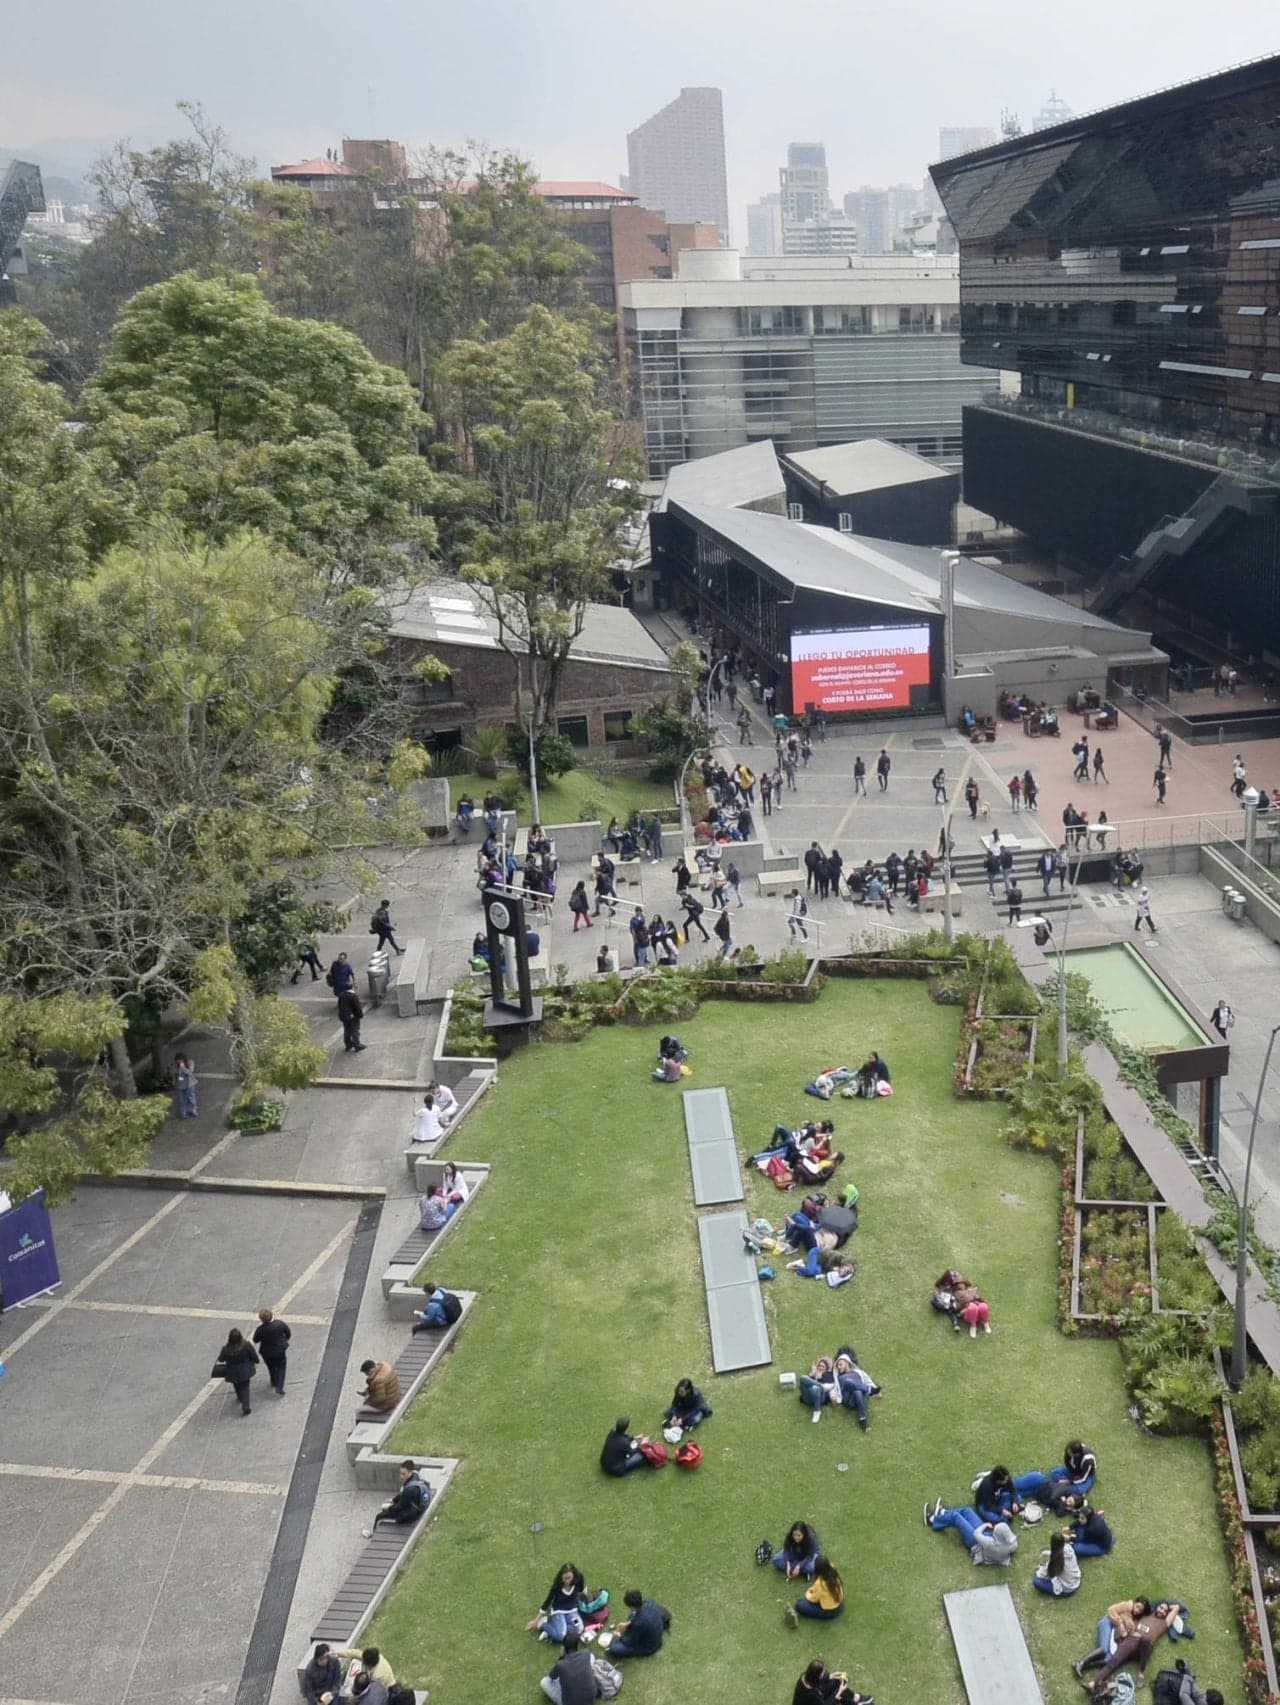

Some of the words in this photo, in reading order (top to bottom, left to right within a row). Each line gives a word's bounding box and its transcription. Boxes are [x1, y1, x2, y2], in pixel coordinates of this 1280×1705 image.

[831, 650, 842, 660] TU
[845, 646, 915, 659] OPORTUNIDAD
[865, 693, 893, 701] SEMANA
